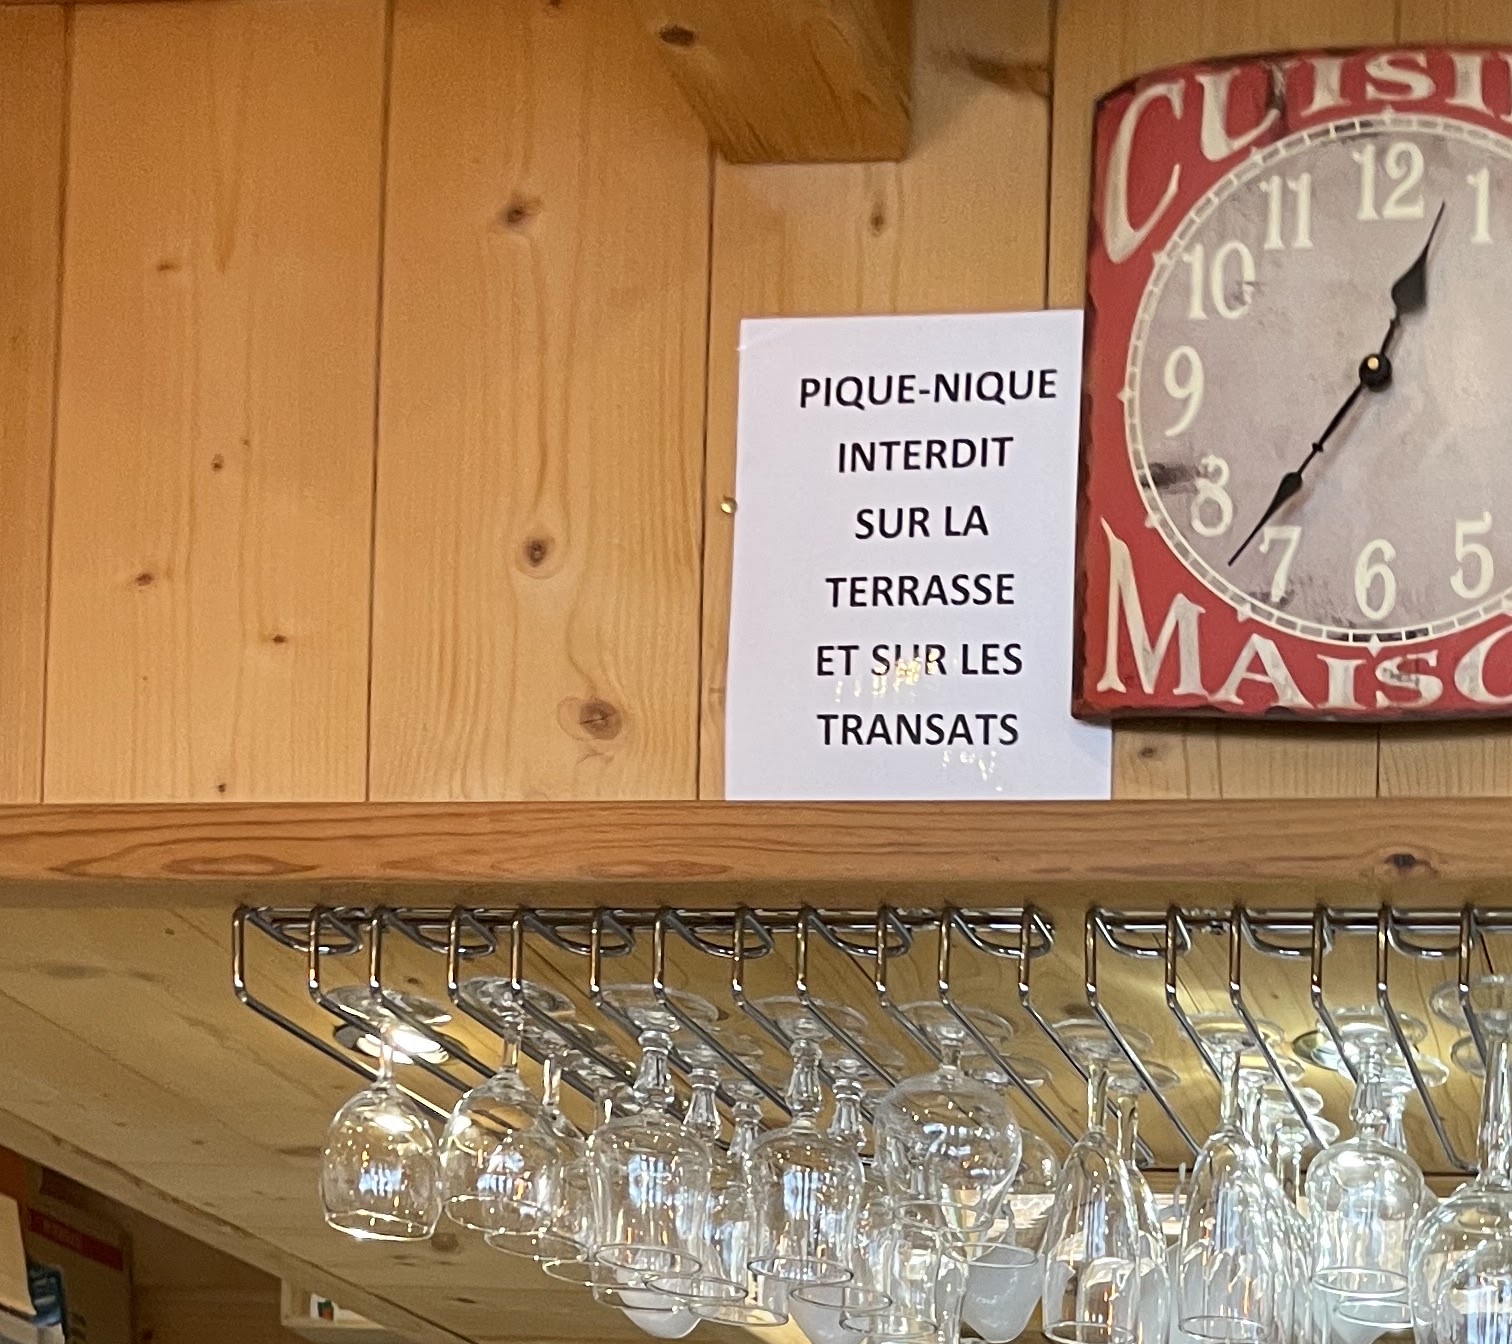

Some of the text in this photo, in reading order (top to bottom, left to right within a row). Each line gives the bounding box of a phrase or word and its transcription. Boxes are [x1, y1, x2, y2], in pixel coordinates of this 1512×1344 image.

[1260, 171, 1313, 249] 11
[1356, 142, 1425, 221] 12
[1467, 167, 1493, 244] 1
[1185, 241, 1257, 320] 10
[799, 368, 1059, 411] PIQUE-NIQUE
[1163, 345, 1204, 436] 9
[838, 436, 1014, 473] INTERDIT
[855, 505, 989, 540] SUR LA
[1190, 454, 1234, 537] 8
[826, 574, 1016, 608] TERRASSE
[1261, 525, 1302, 608] 7
[1354, 539, 1397, 620] 6
[1450, 510, 1494, 599] 5
[816, 643, 1023, 677] ET SUR LES
[816, 713, 1019, 746] TRANSATS
